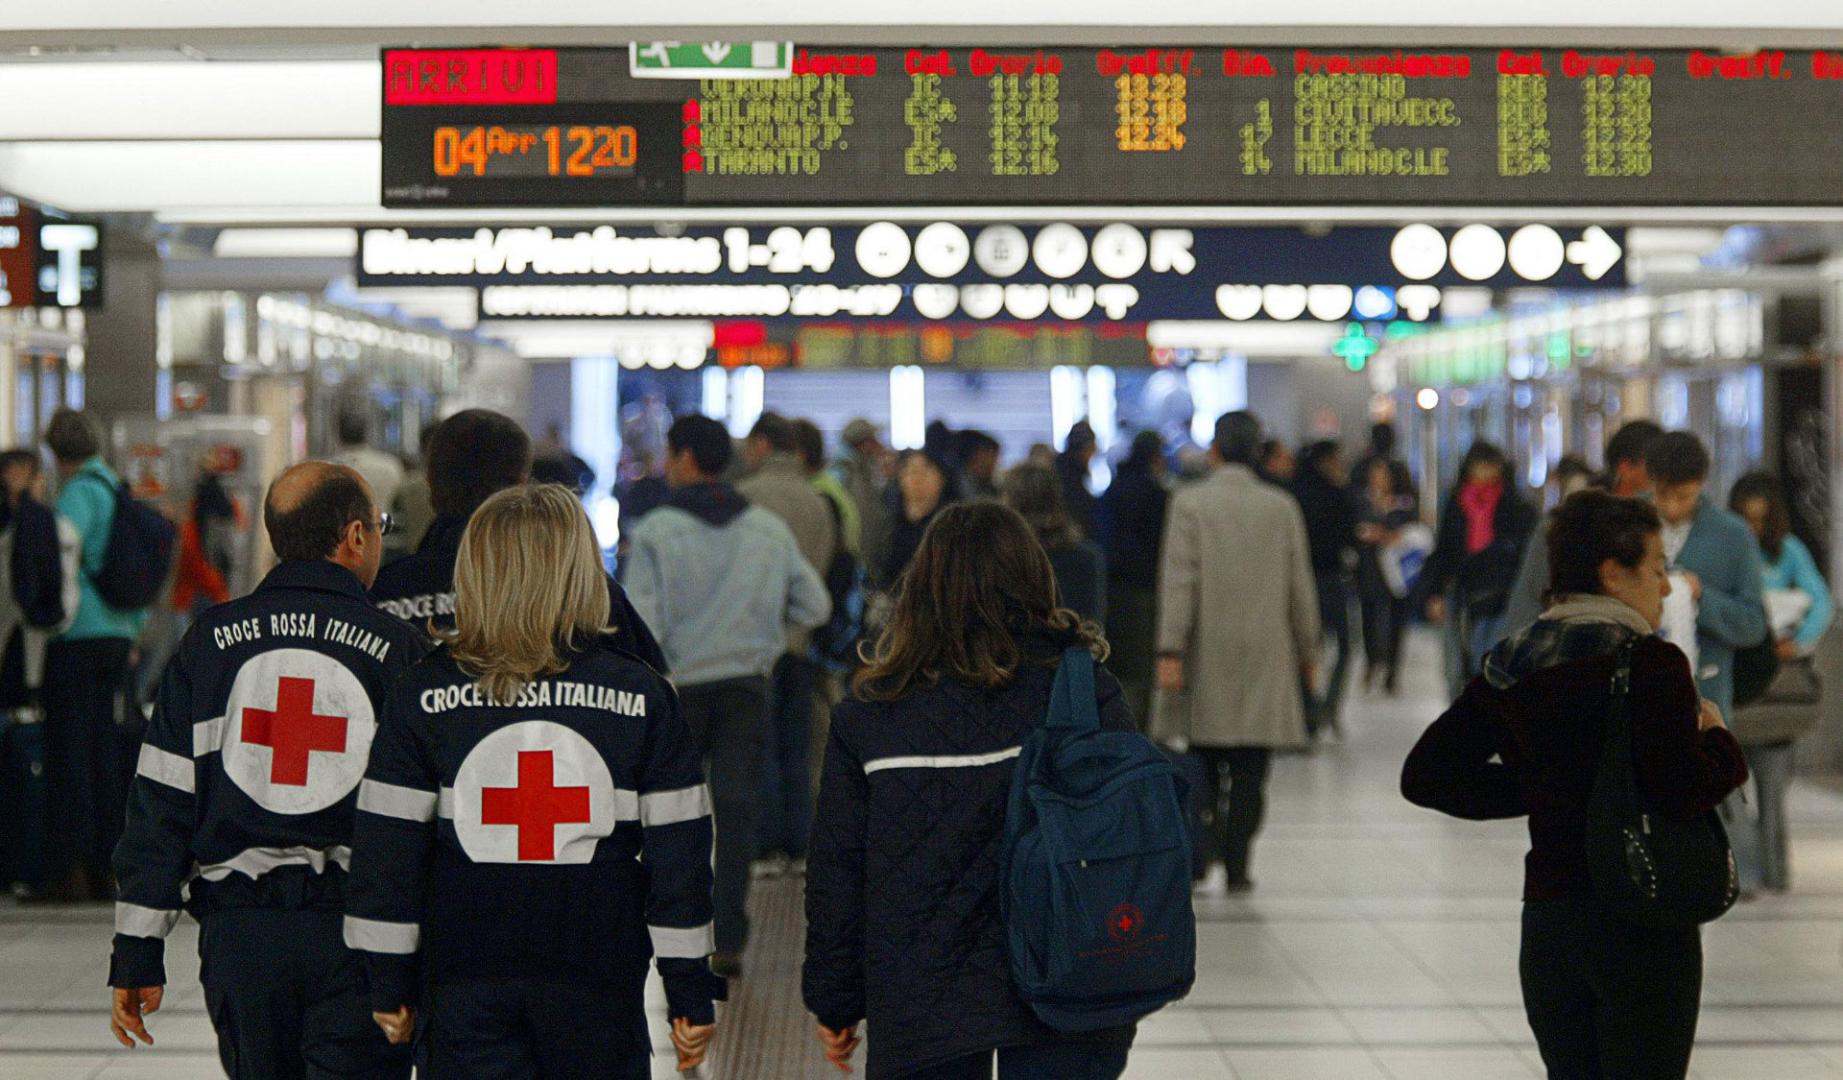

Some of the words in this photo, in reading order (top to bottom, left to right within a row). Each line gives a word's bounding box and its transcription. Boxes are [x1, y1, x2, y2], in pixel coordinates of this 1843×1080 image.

[213, 617, 261, 650] CROCE
[270, 612, 316, 639] ROSSA
[323, 617, 390, 663] ITALIANA
[420, 682, 483, 714] CROCE
[555, 680, 647, 717] ITALIANA
